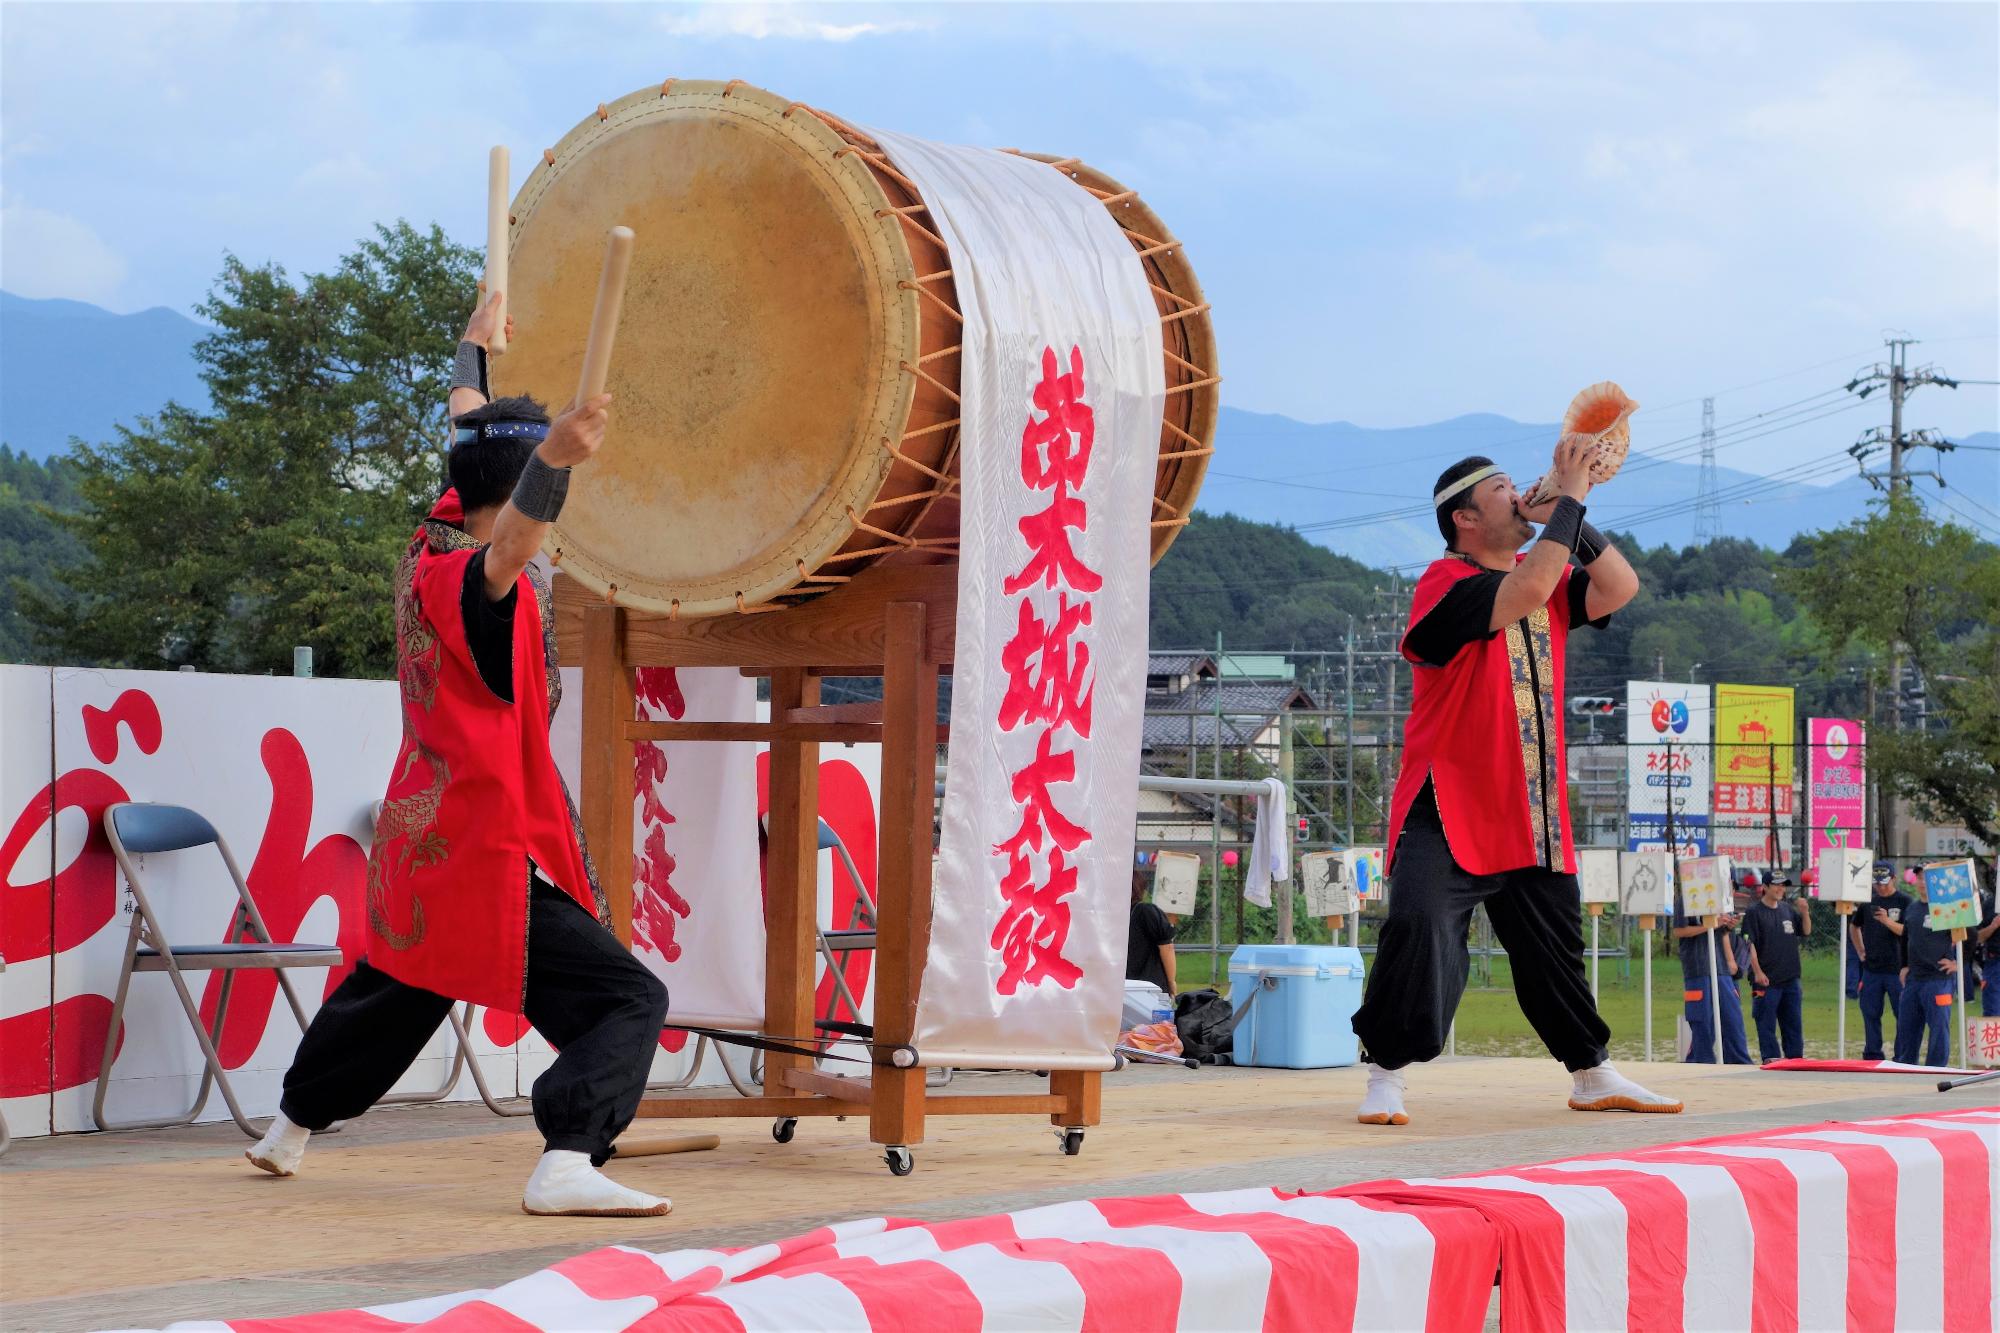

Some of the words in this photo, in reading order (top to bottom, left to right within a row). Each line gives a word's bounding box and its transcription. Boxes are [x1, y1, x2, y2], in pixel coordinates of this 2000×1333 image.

[989, 344, 1103, 996] 苗木城太鼓
[1646, 752, 1692, 771] ネクスト
